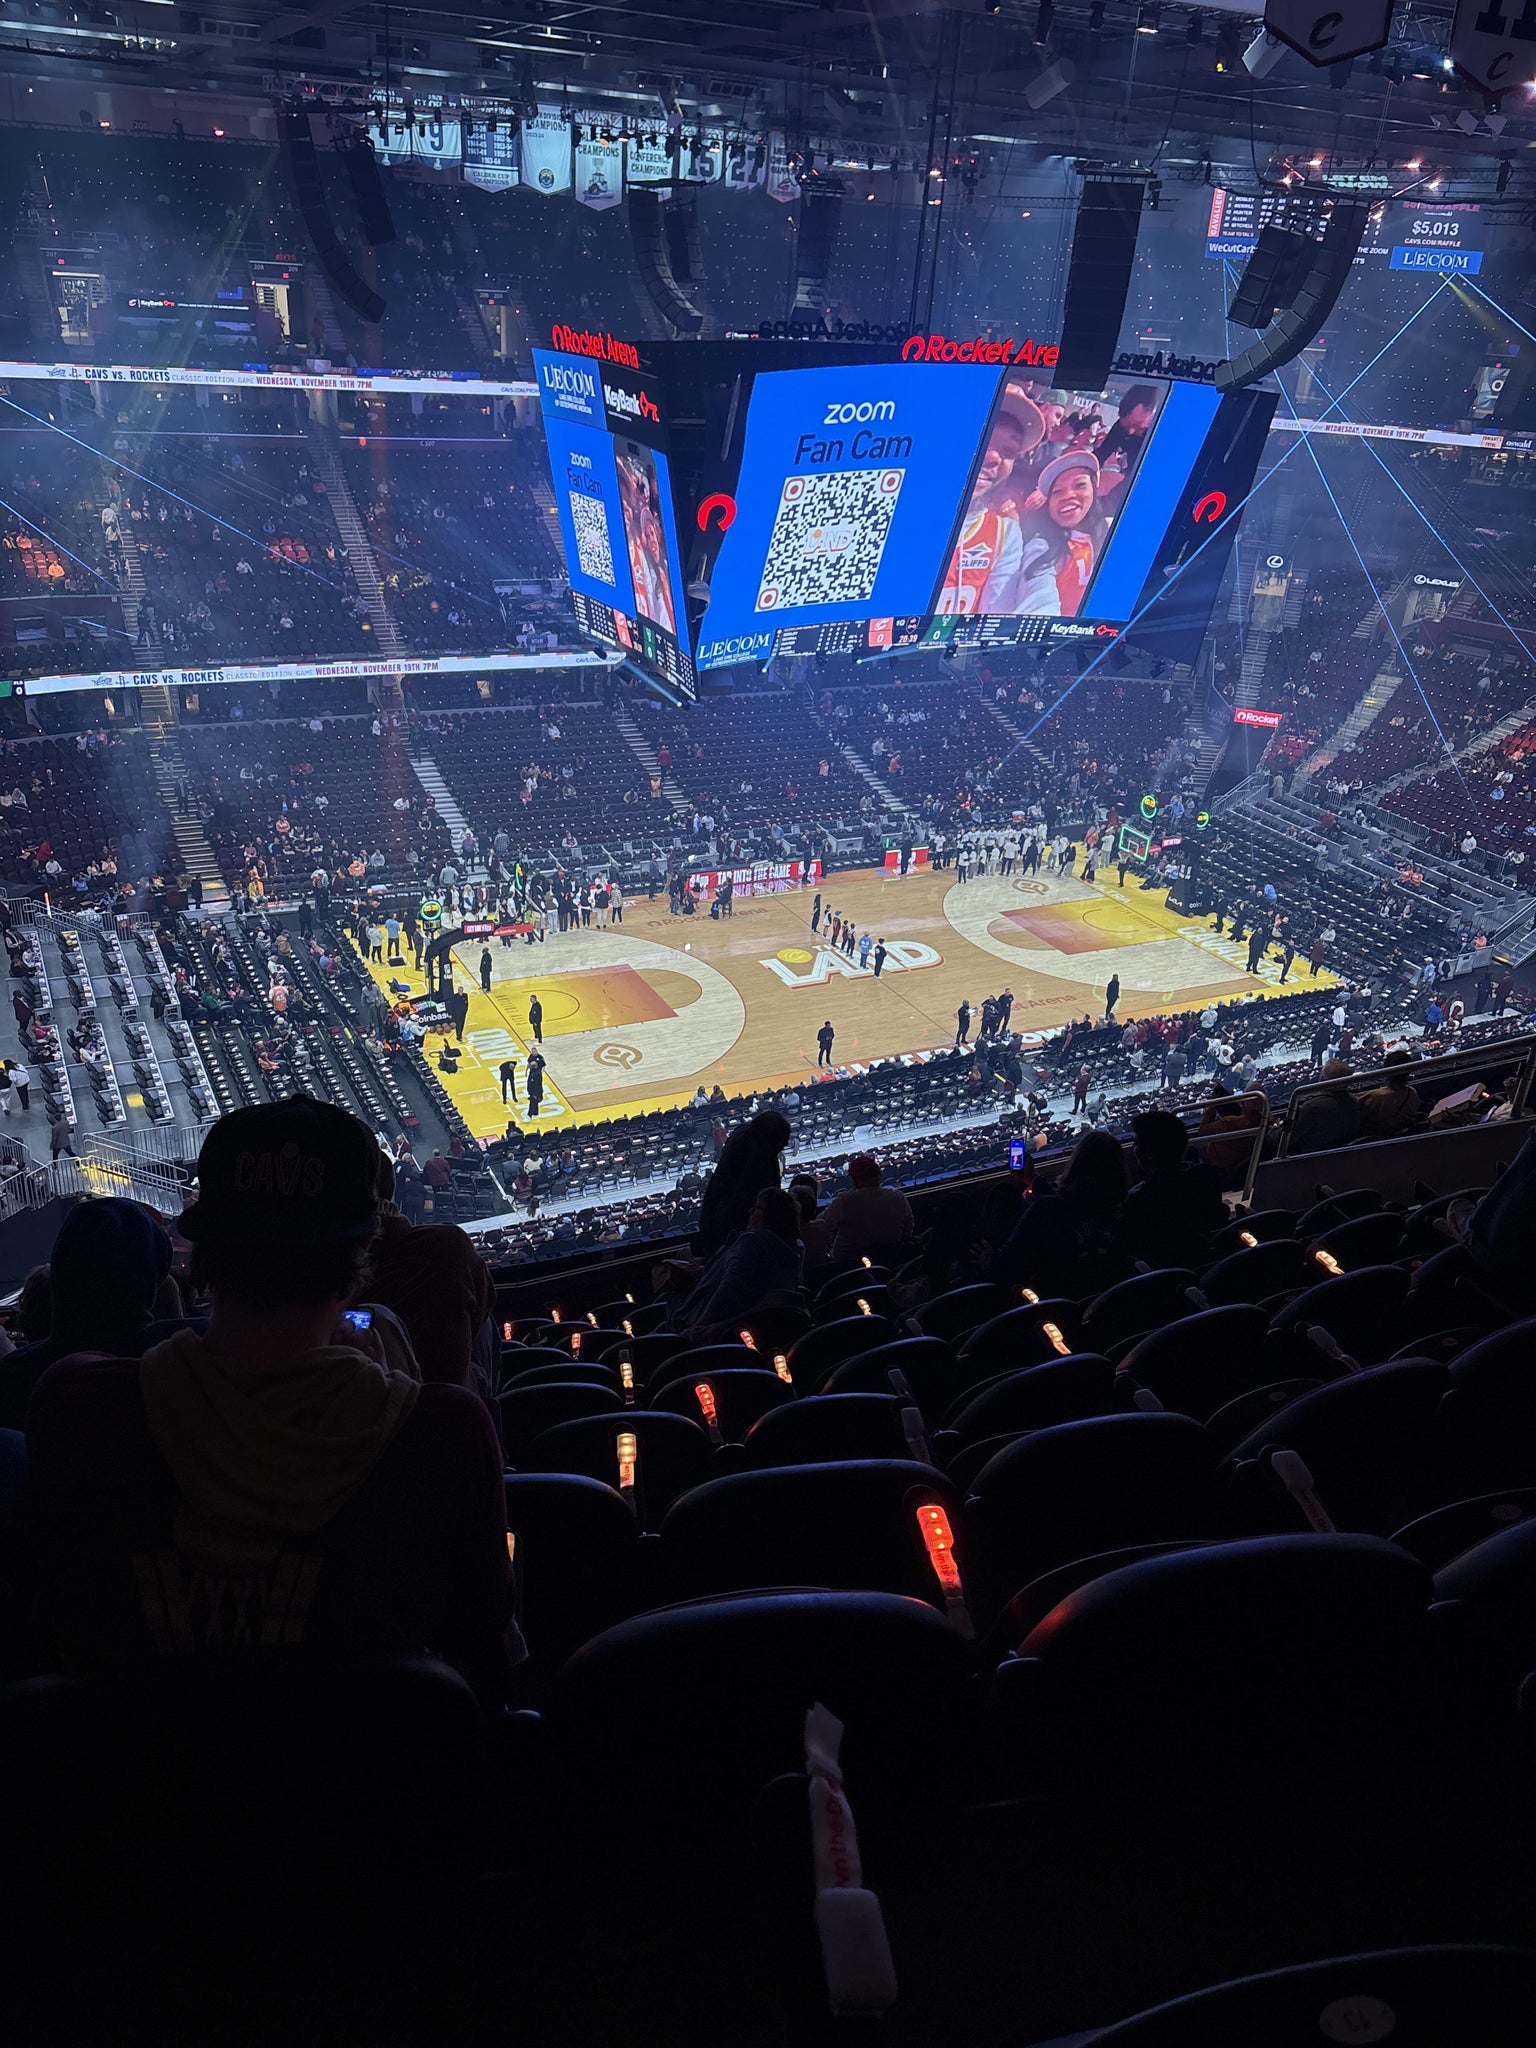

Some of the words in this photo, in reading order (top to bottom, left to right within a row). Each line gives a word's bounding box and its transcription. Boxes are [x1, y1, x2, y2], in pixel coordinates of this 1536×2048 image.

[578, 144, 620, 158] CHAMPIONS
[631, 163, 668, 176] CHAMPIONS
[1412, 220, 1460, 237] $5,013
[1404, 238, 1461, 247] CAVS.COM/RAFFLE
[563, 325, 607, 360] Rocket
[608, 333, 640, 369] Arena
[925, 335, 1014, 363] Rocket
[1013, 339, 1060, 366] Are
[85, 368, 108, 380] CAVS
[130, 371, 170, 382] ROCKETS
[205, 376, 235, 384] EDITION
[301, 378, 337, 388] NOVEMBER
[339, 379, 356, 389] 19TH
[357, 380, 373, 389] 7PM
[604, 384, 641, 416] KeyBank
[823, 401, 896, 425] zoom
[1362, 427, 1394, 437] NOVEMBER
[794, 433, 845, 465] Fan
[851, 429, 913, 460] Cam
[1506, 440, 1532, 448] oswald
[570, 452, 593, 470] zoom
[567, 468, 582, 490] Fan
[584, 474, 602, 496] Cam
[1426, 577, 1460, 588] LEXUS
[932, 630, 941, 640] 0
[1050, 622, 1095, 636] KeyBank
[877, 633, 884, 643] 0
[133, 674, 158, 686] CAVS
[181, 671, 224, 683] ROCKETS
[226, 672, 257, 680] CLASSIC
[261, 670, 293, 679] EDITION
[363, 663, 402, 673] NOVEMBER
[404, 662, 421, 672] 19TH
[423, 662, 439, 671] 7PM
[15, 686, 23, 695] 0
[1246, 713, 1279, 725] Rocket
[733, 869, 752, 884] INTO
[769, 863, 792, 879] GAME
[759, 941, 946, 990] LAND
[1027, 994, 1078, 1009] Arena
[233, 1151, 327, 1198] CAVS
